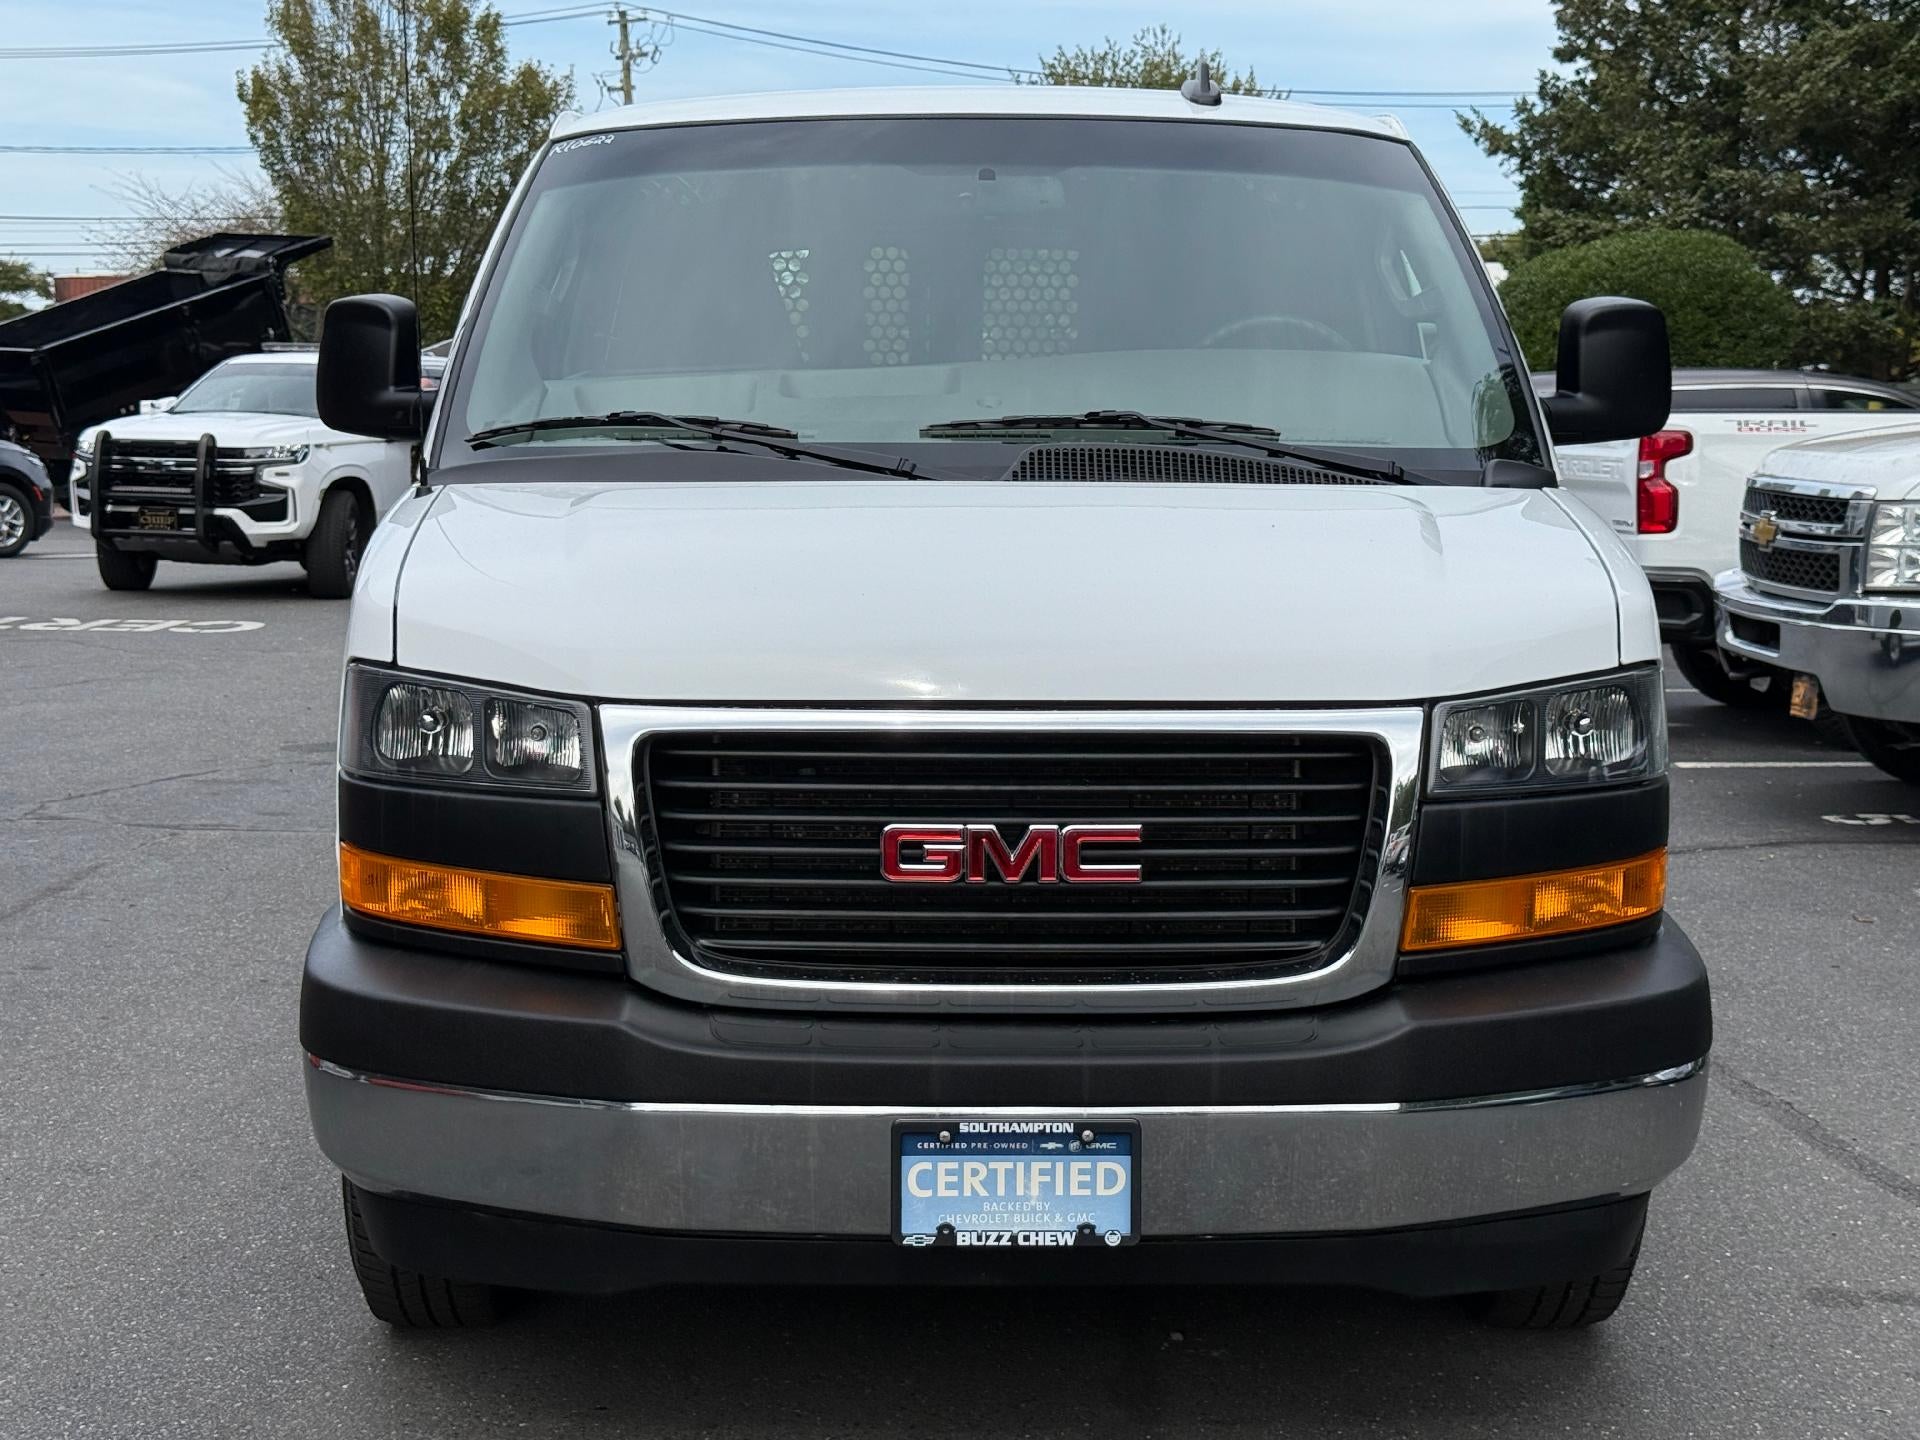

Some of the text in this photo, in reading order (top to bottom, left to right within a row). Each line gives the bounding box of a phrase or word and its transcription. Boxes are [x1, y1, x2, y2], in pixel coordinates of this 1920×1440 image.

[1723, 419, 1819, 427] TRAIL
[880, 824, 1142, 883] GMC
[959, 1122, 1074, 1133] SOUTHAMPTON
[907, 1161, 1127, 1198] CERTIFIED
[983, 1201, 1050, 1211] BACKED BY
[938, 1212, 1096, 1223] CHEVROLET BUICK & GMC
[956, 1231, 1076, 1246] BUZZ CHEW
